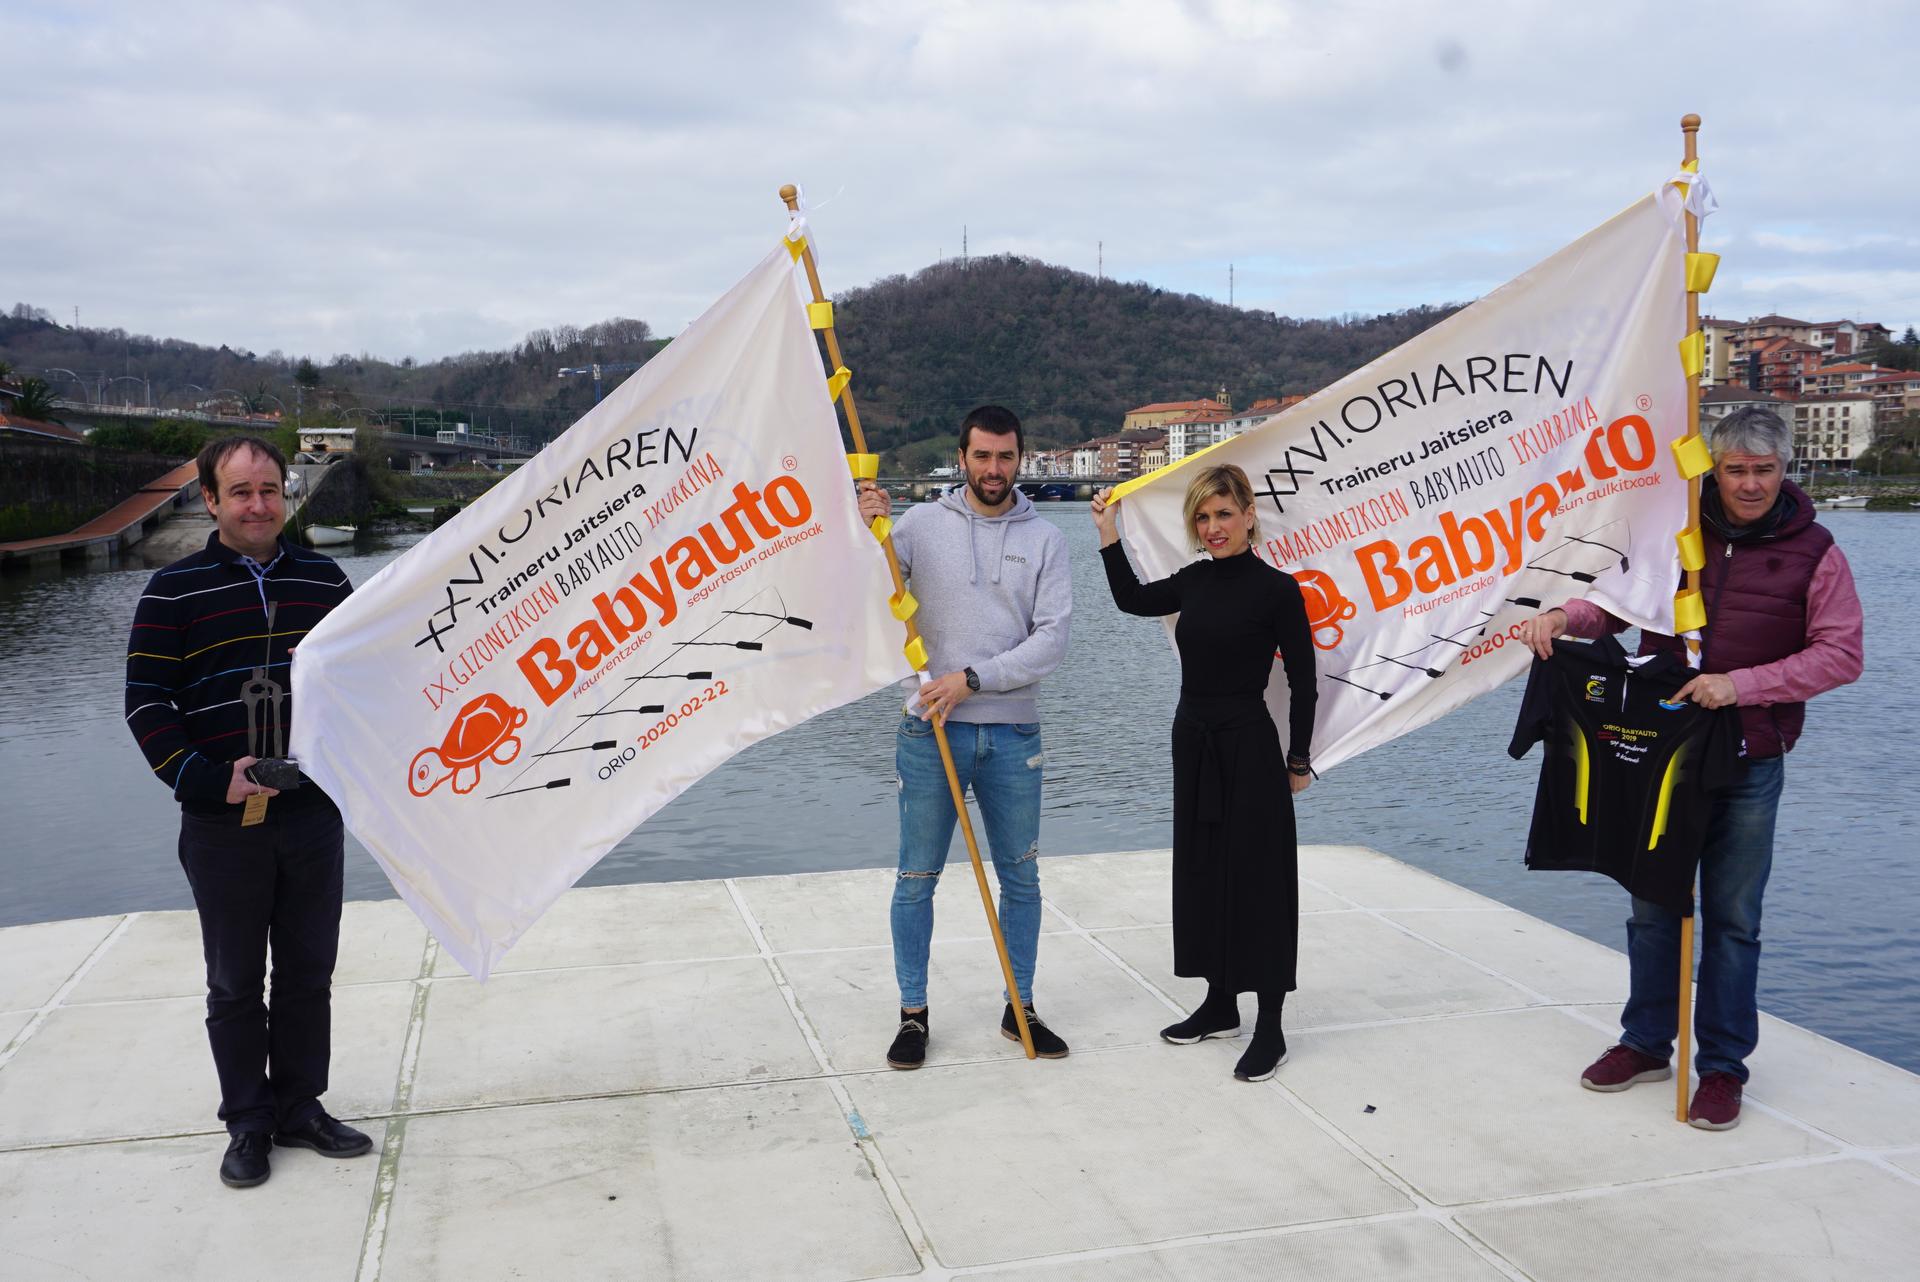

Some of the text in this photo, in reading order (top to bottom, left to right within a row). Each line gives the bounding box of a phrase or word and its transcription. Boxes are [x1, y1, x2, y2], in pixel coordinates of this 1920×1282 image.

[1253, 353, 1573, 514] XXVI.ORIAREN
[1266, 395, 1599, 569] EMAKUMEZKOEN BABYAUTO IKURRINA
[1320, 408, 1514, 496] Traineru Jaitsiera
[1353, 414, 1657, 613] Babyato
[421, 452, 725, 711] IX.GIZONEZKOEN BABYAUTO IKURRINA
[475, 483, 647, 616] Traineru Jaitsiera
[516, 474, 813, 708] Babyauto
[572, 522, 824, 699] Haurrentzako segurtasun aulkitxoak
[1403, 471, 1662, 619] Haurrentzako aulkitxoak
[598, 680, 730, 781] ORIO 2020-02-22
[1602, 724, 1621, 732] ORIO
[1621, 727, 1658, 738] BABYAUTO
